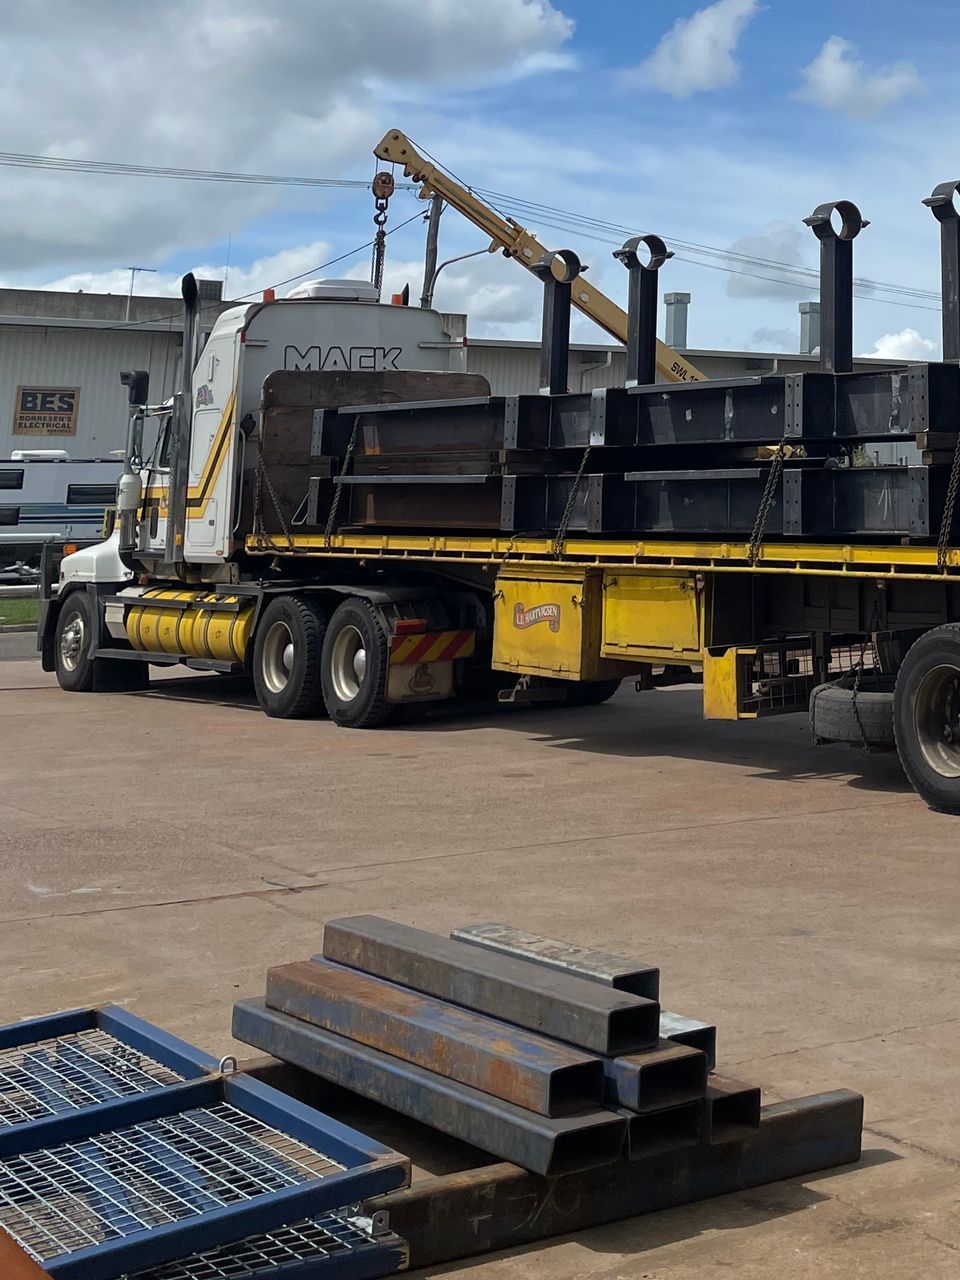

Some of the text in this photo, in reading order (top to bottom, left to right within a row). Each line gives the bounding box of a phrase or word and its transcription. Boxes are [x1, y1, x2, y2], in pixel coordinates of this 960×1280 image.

[284, 345, 402, 370] MACK
[671, 361, 688, 381] SWL
[21, 392, 75, 411] BES
